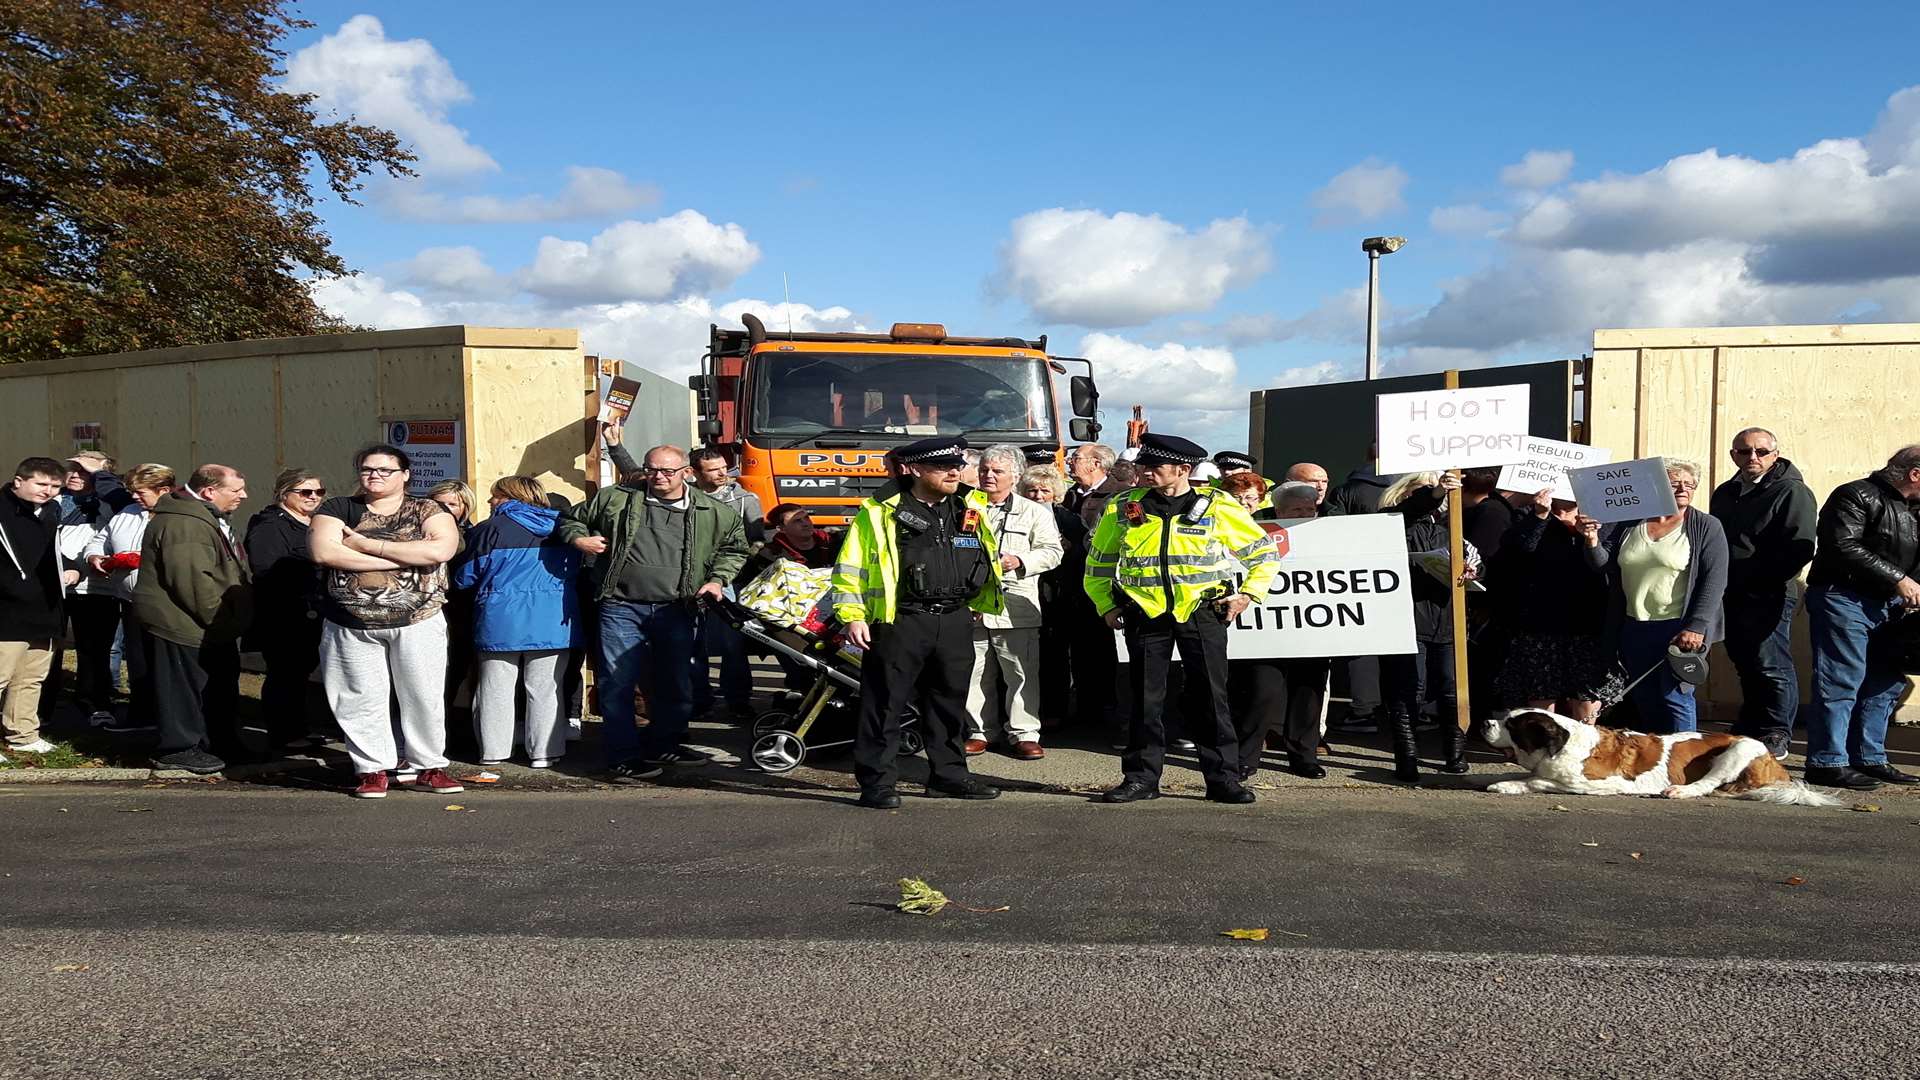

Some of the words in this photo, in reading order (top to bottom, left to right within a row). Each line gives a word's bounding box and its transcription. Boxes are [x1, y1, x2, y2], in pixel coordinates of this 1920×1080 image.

[1410, 398, 1507, 422] HOOT
[1407, 433, 1528, 457] SUPPORT
[1527, 443, 1584, 461] REBUILD
[1518, 459, 1577, 475] RICK-B
[1596, 468, 1632, 481] SAVE
[780, 479, 836, 488] DAF
[1518, 469, 1559, 485] BRICK
[1605, 484, 1634, 497] OUR
[1605, 496, 1641, 508] PUBS
